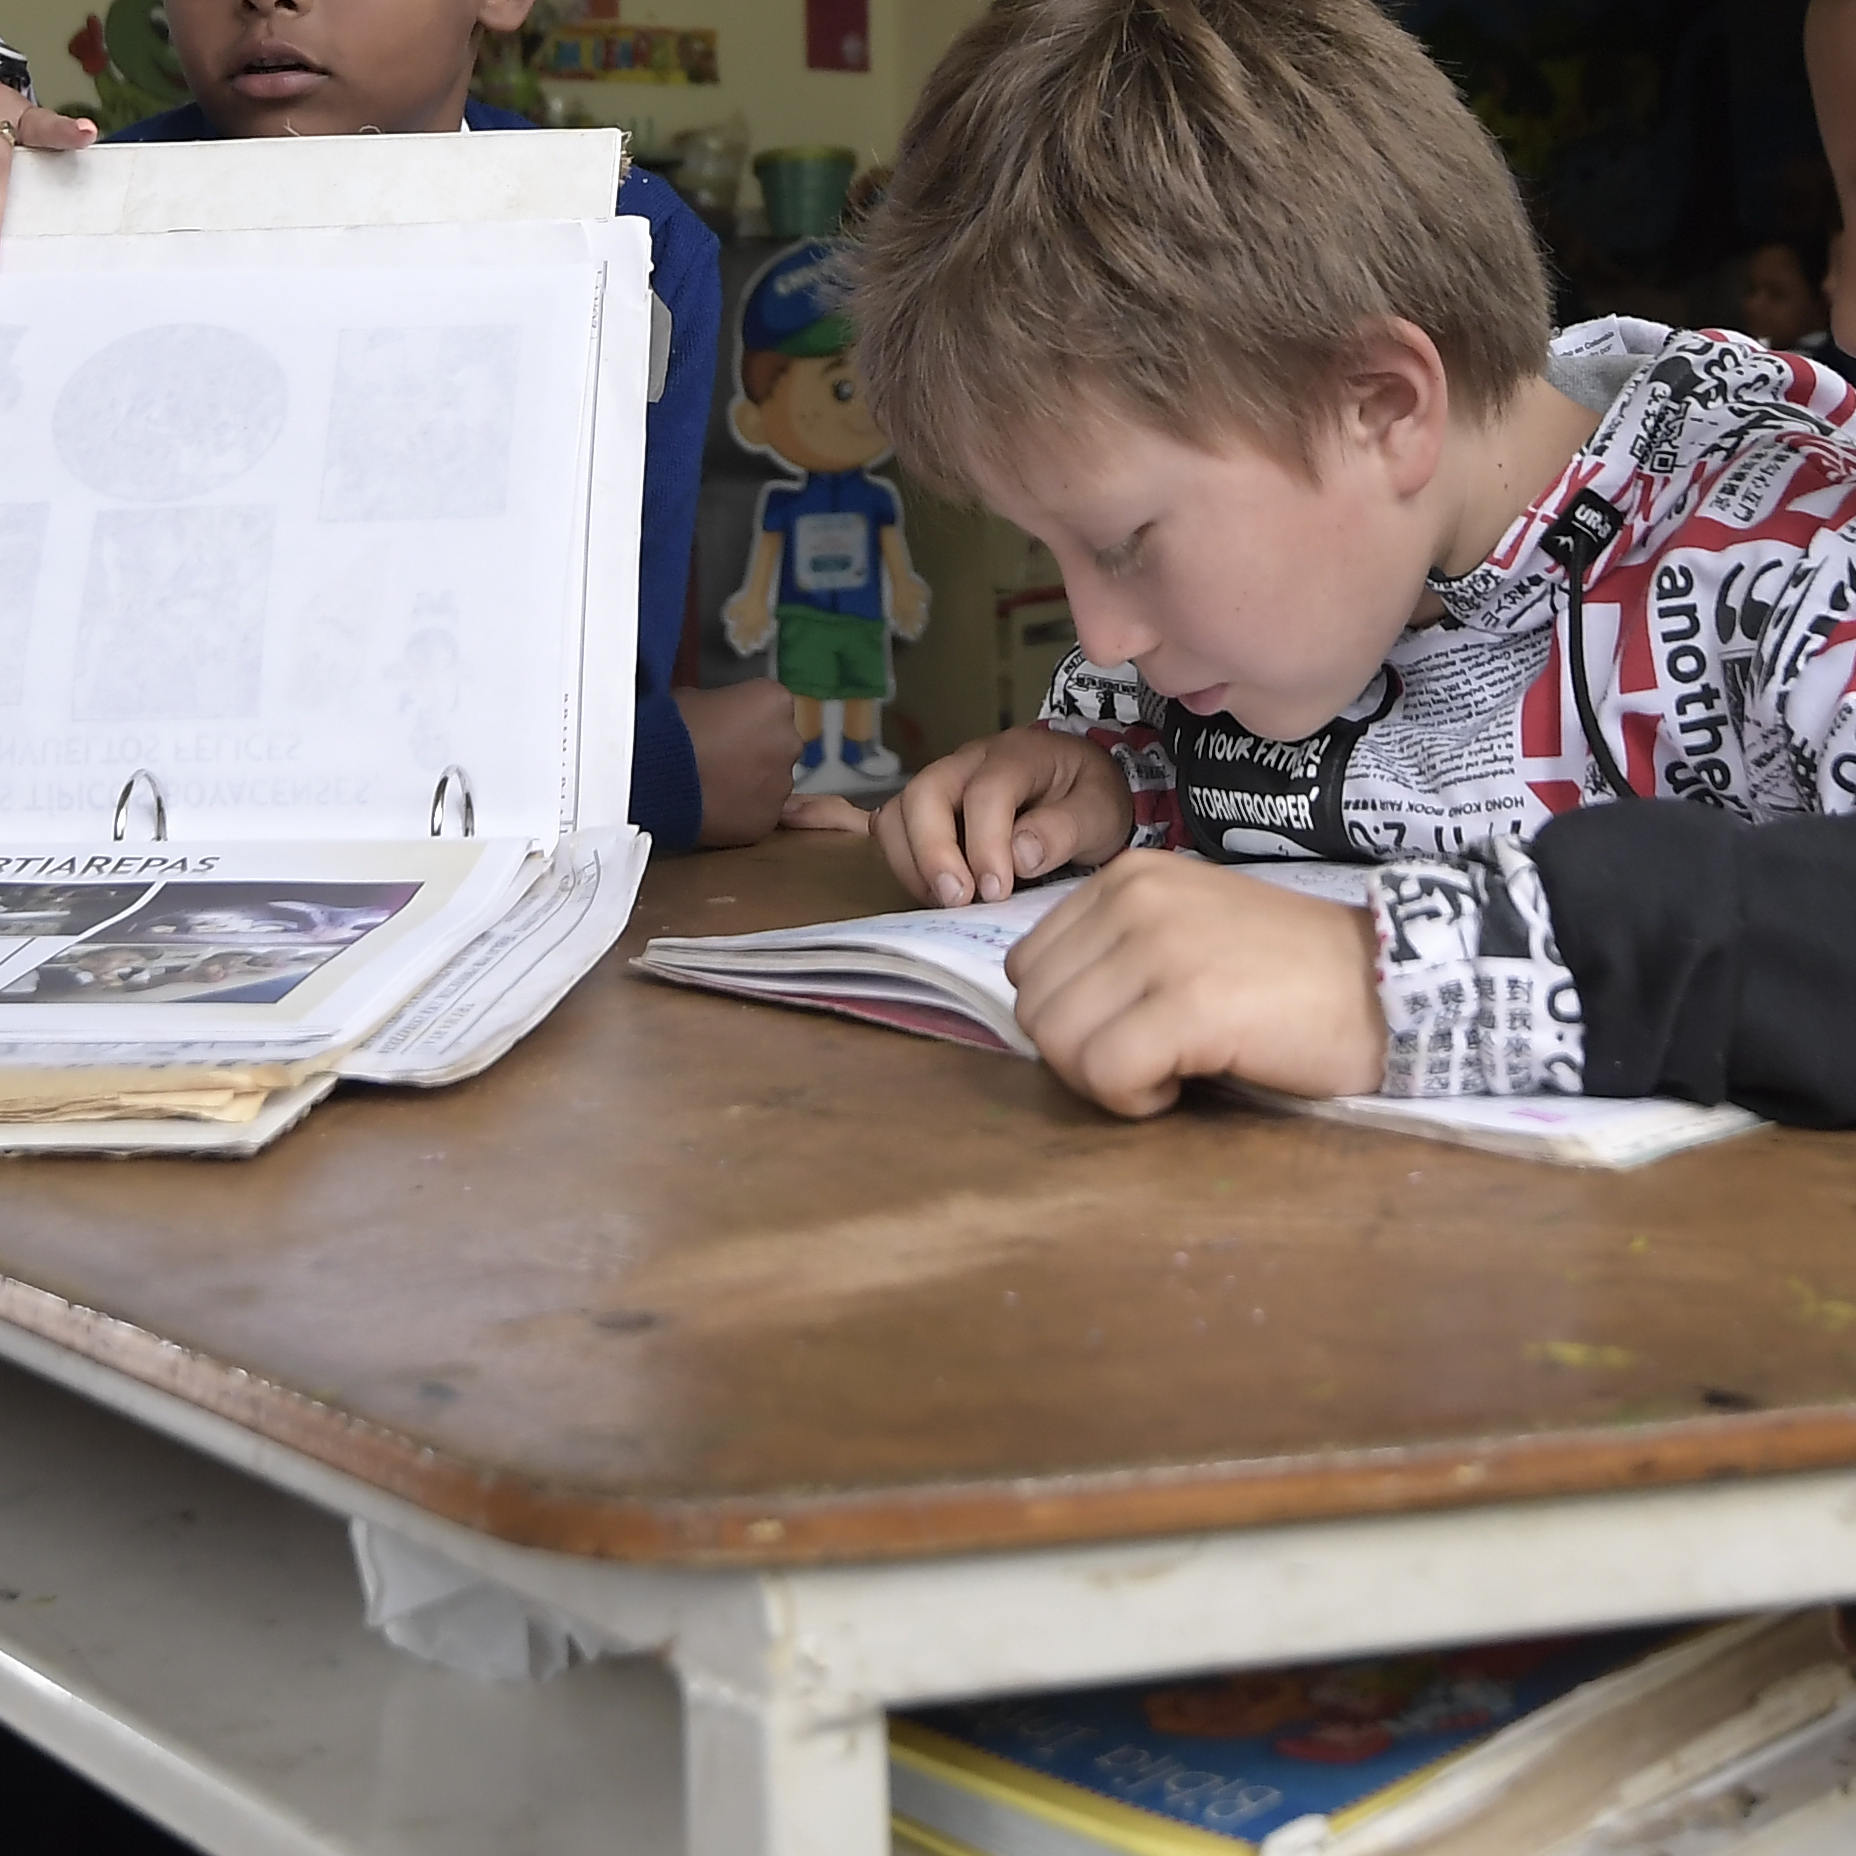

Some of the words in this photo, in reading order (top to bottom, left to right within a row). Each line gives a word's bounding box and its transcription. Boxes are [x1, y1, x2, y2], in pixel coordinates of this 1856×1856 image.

[1210, 729, 1254, 761] YOUR
[1448, 802, 1481, 816] KONG
[1484, 795, 1524, 810] HONG
